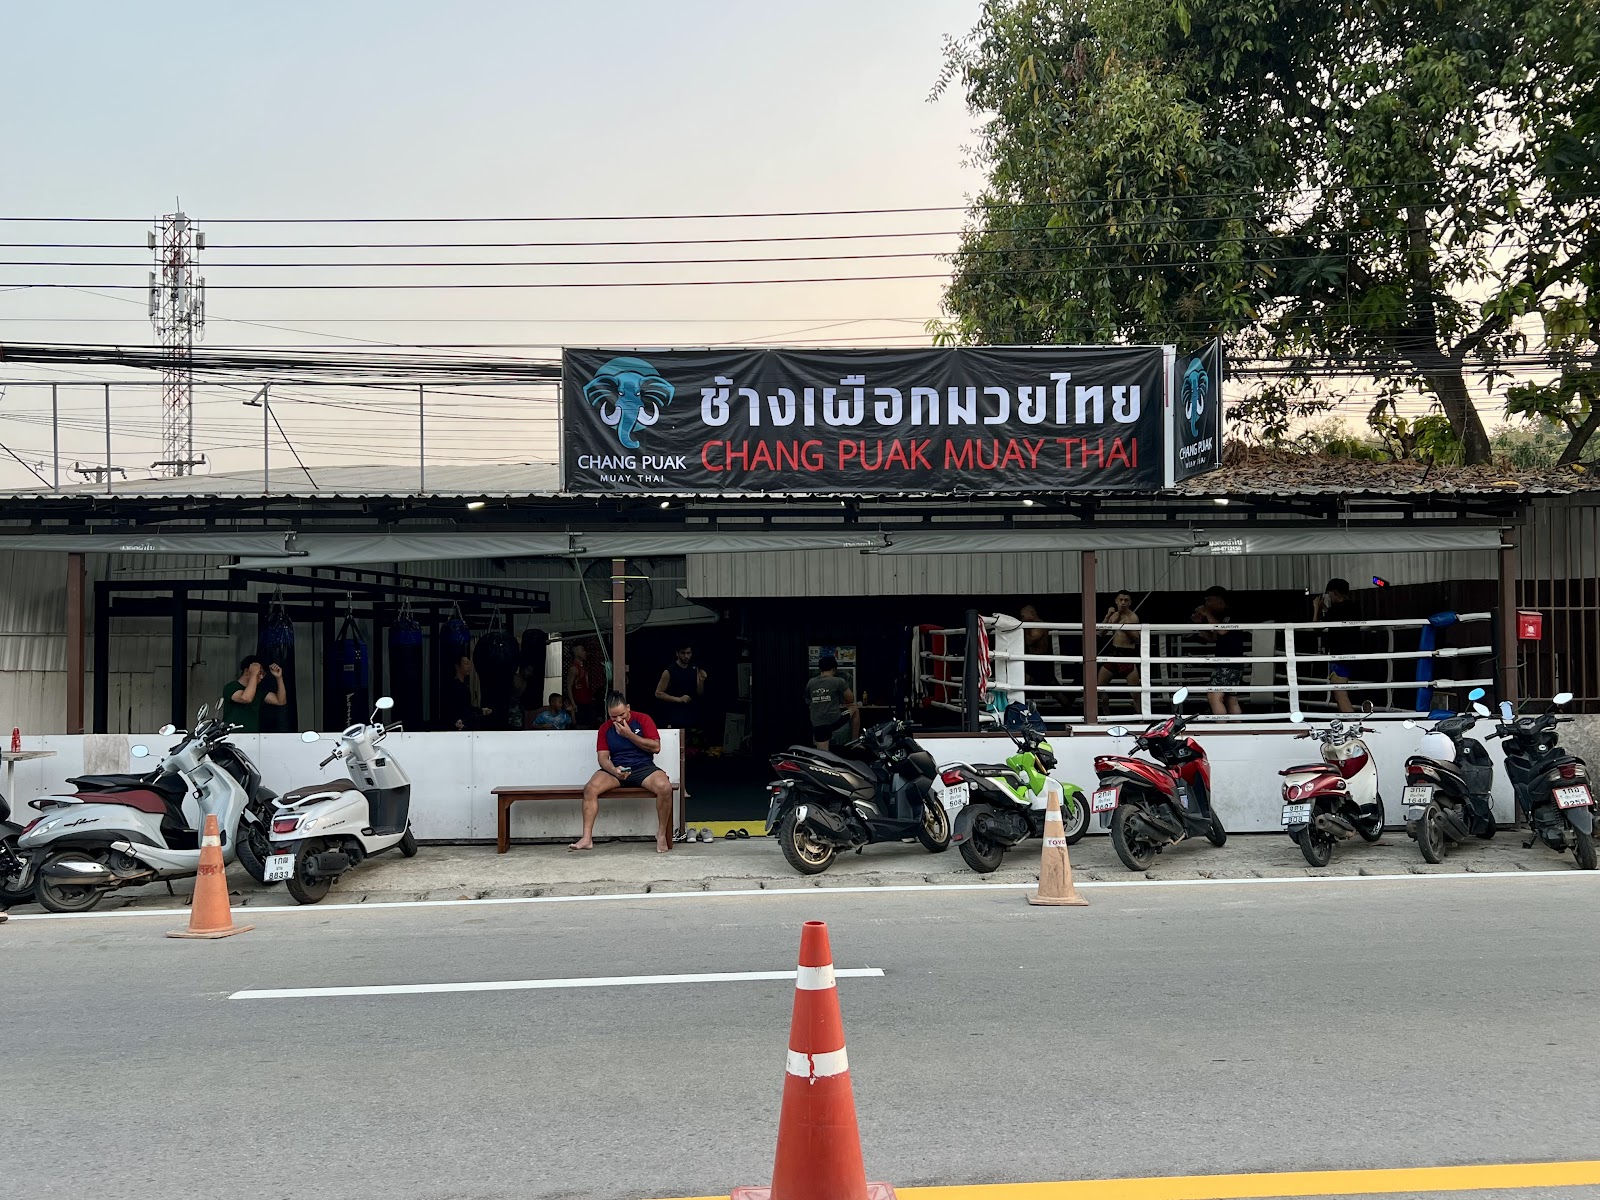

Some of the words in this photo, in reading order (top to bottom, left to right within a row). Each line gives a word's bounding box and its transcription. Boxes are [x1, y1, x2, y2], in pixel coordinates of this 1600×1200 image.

[700, 372, 1141, 427] ช้างเผือกมวยไทย
[701, 439, 824, 472] CHANG
[838, 438, 933, 471] PUAK
[944, 437, 1045, 470] MUAY
[1055, 437, 1138, 469] THAI
[1180, 443, 1198, 459] CHANG
[1198, 437, 1212, 453] PUAK
[577, 454, 636, 470] CHANG
[642, 455, 687, 470] PUAK
[600, 474, 632, 483] MUAY
[638, 474, 664, 483] THAI
[268, 870, 289, 880] 8833
